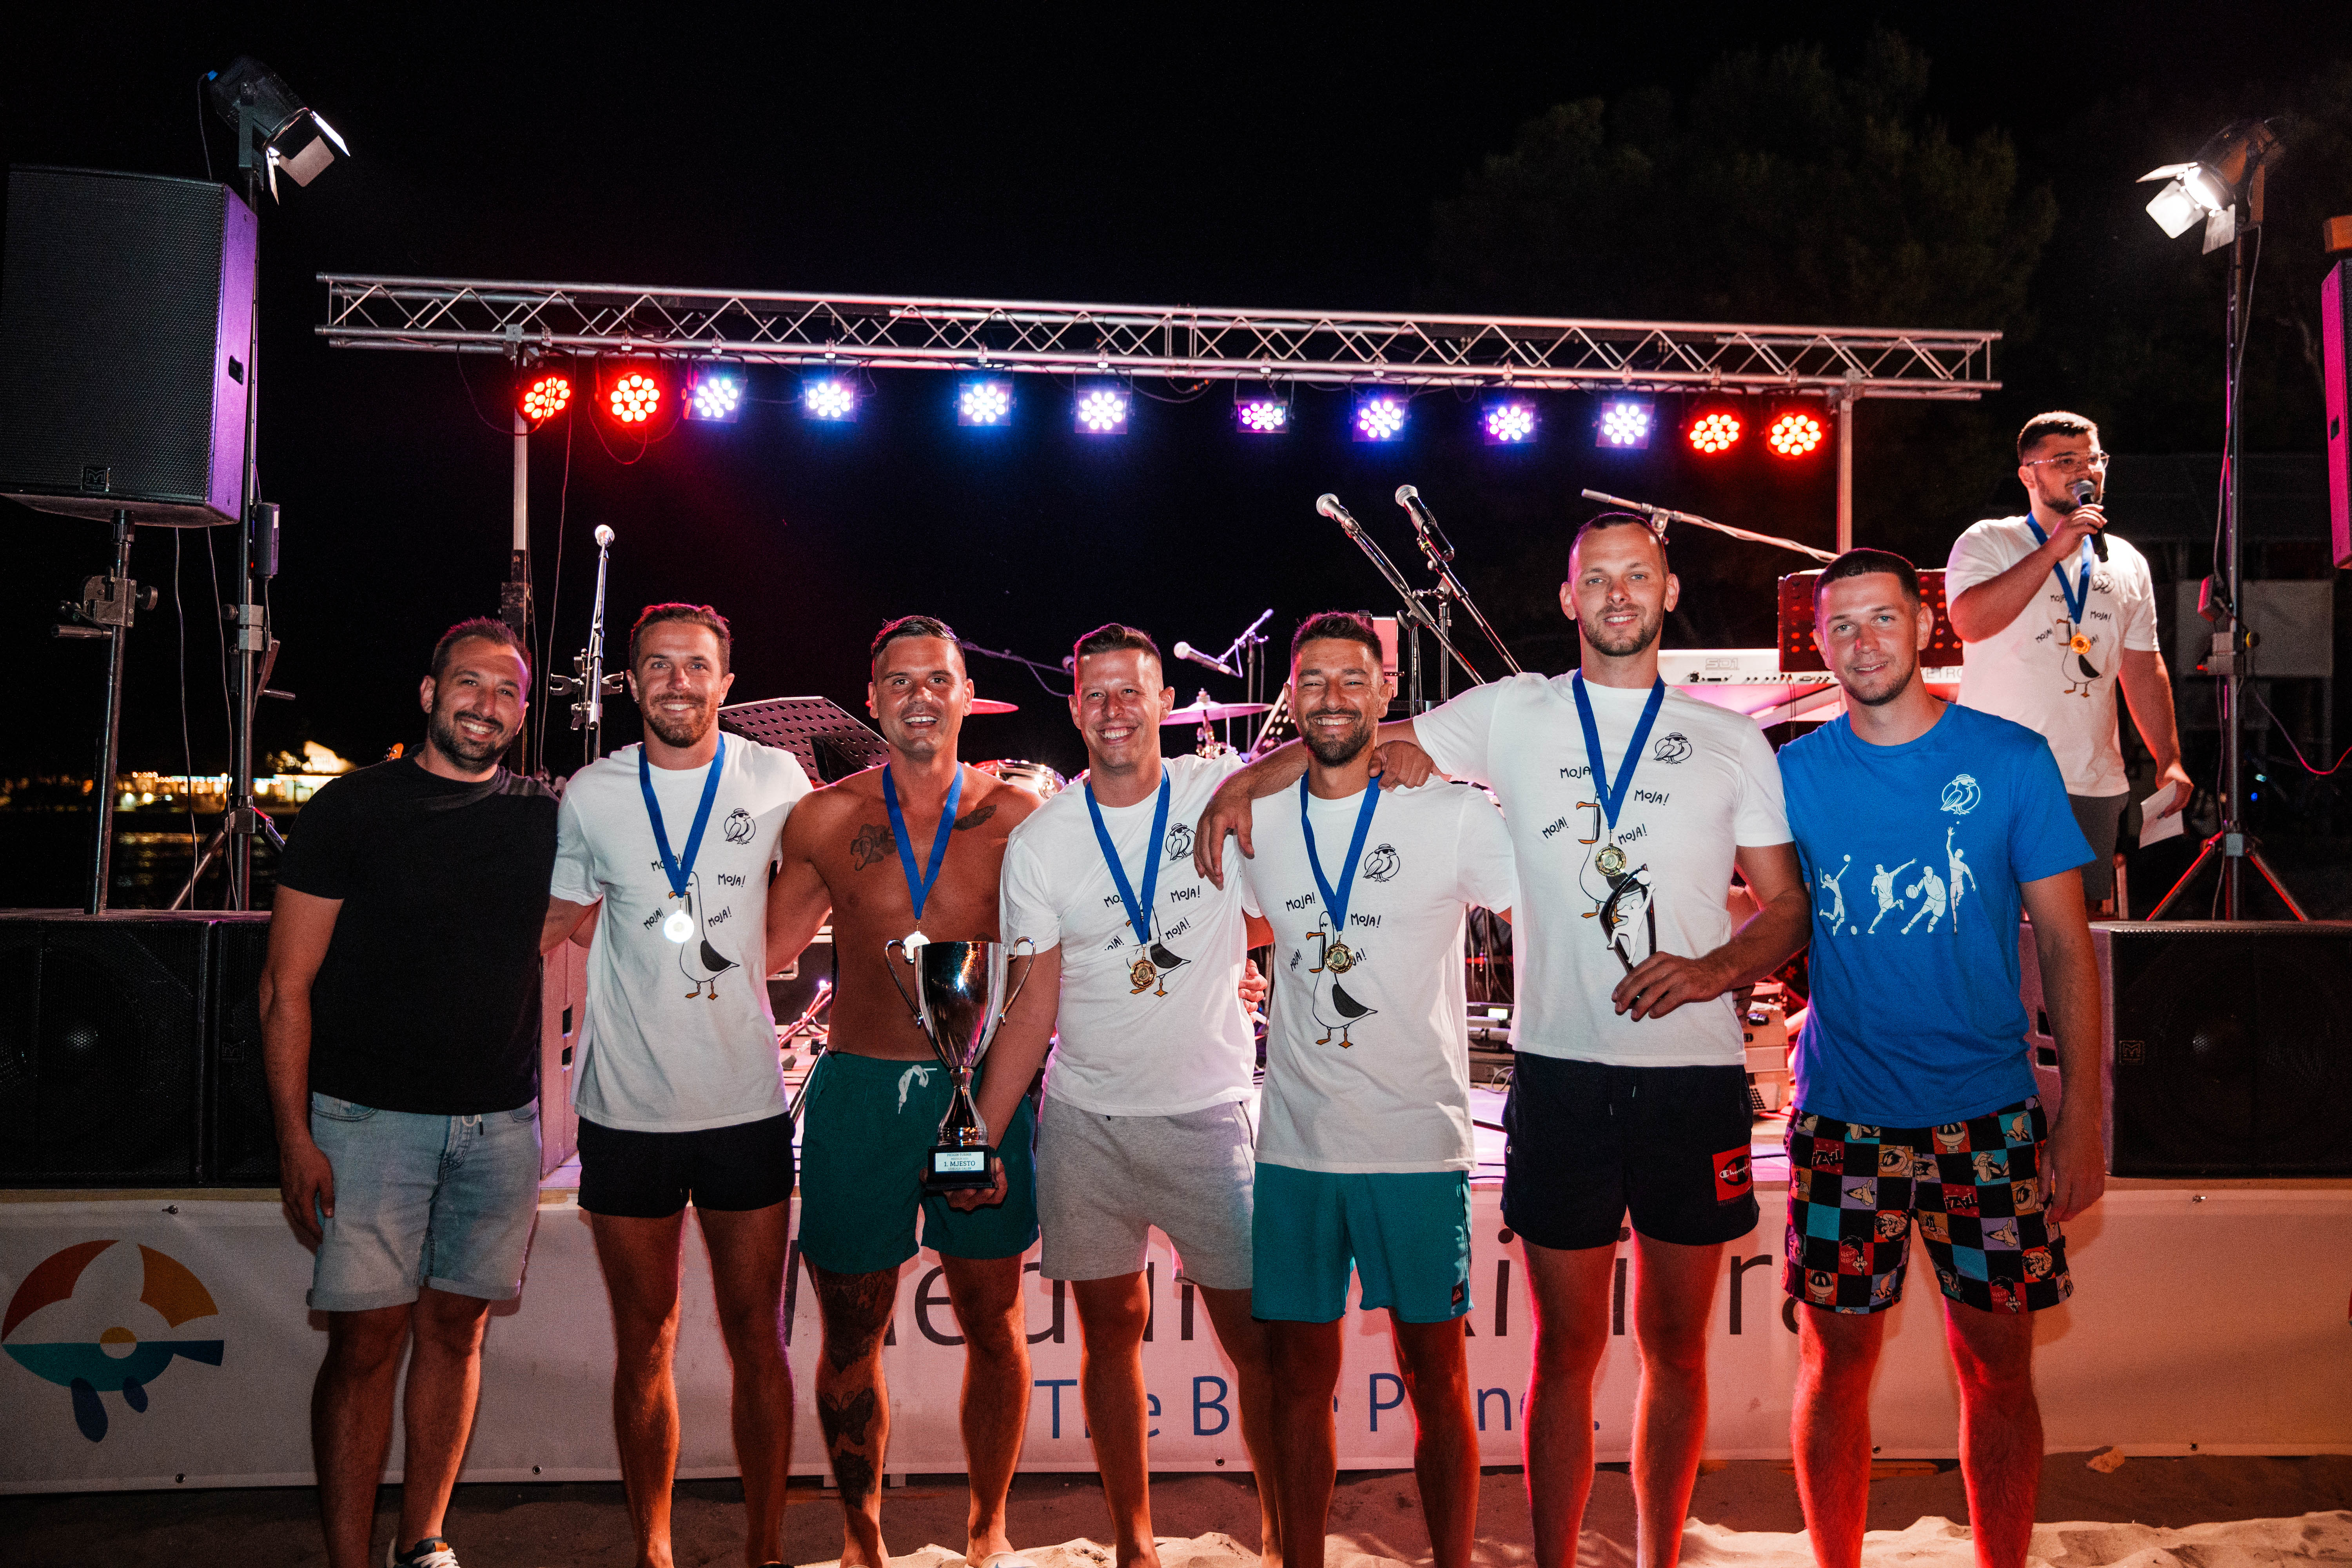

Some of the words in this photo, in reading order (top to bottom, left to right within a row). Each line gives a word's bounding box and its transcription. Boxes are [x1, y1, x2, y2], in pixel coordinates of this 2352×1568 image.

[2090, 611, 2112, 622] MOJA!
[1705, 658, 1739, 668] SD1
[1560, 766, 1591, 779] MOJA
[1634, 789, 1670, 806] MOJA!
[1542, 817, 1569, 839] MOJA!
[1618, 823, 1647, 845] MOJA!
[718, 873, 746, 887] MOJA!
[1170, 885, 1200, 903] MOJA!
[1286, 892, 1316, 911] MOJA!
[643, 907, 666, 930] MOJA!
[708, 906, 732, 927] MOJA!
[1350, 913, 1381, 928] MOJA!
[1165, 917, 1191, 940] MOJA!
[1290, 949, 1303, 972] MOJA!
[1352, 948, 1367, 966] JA!
